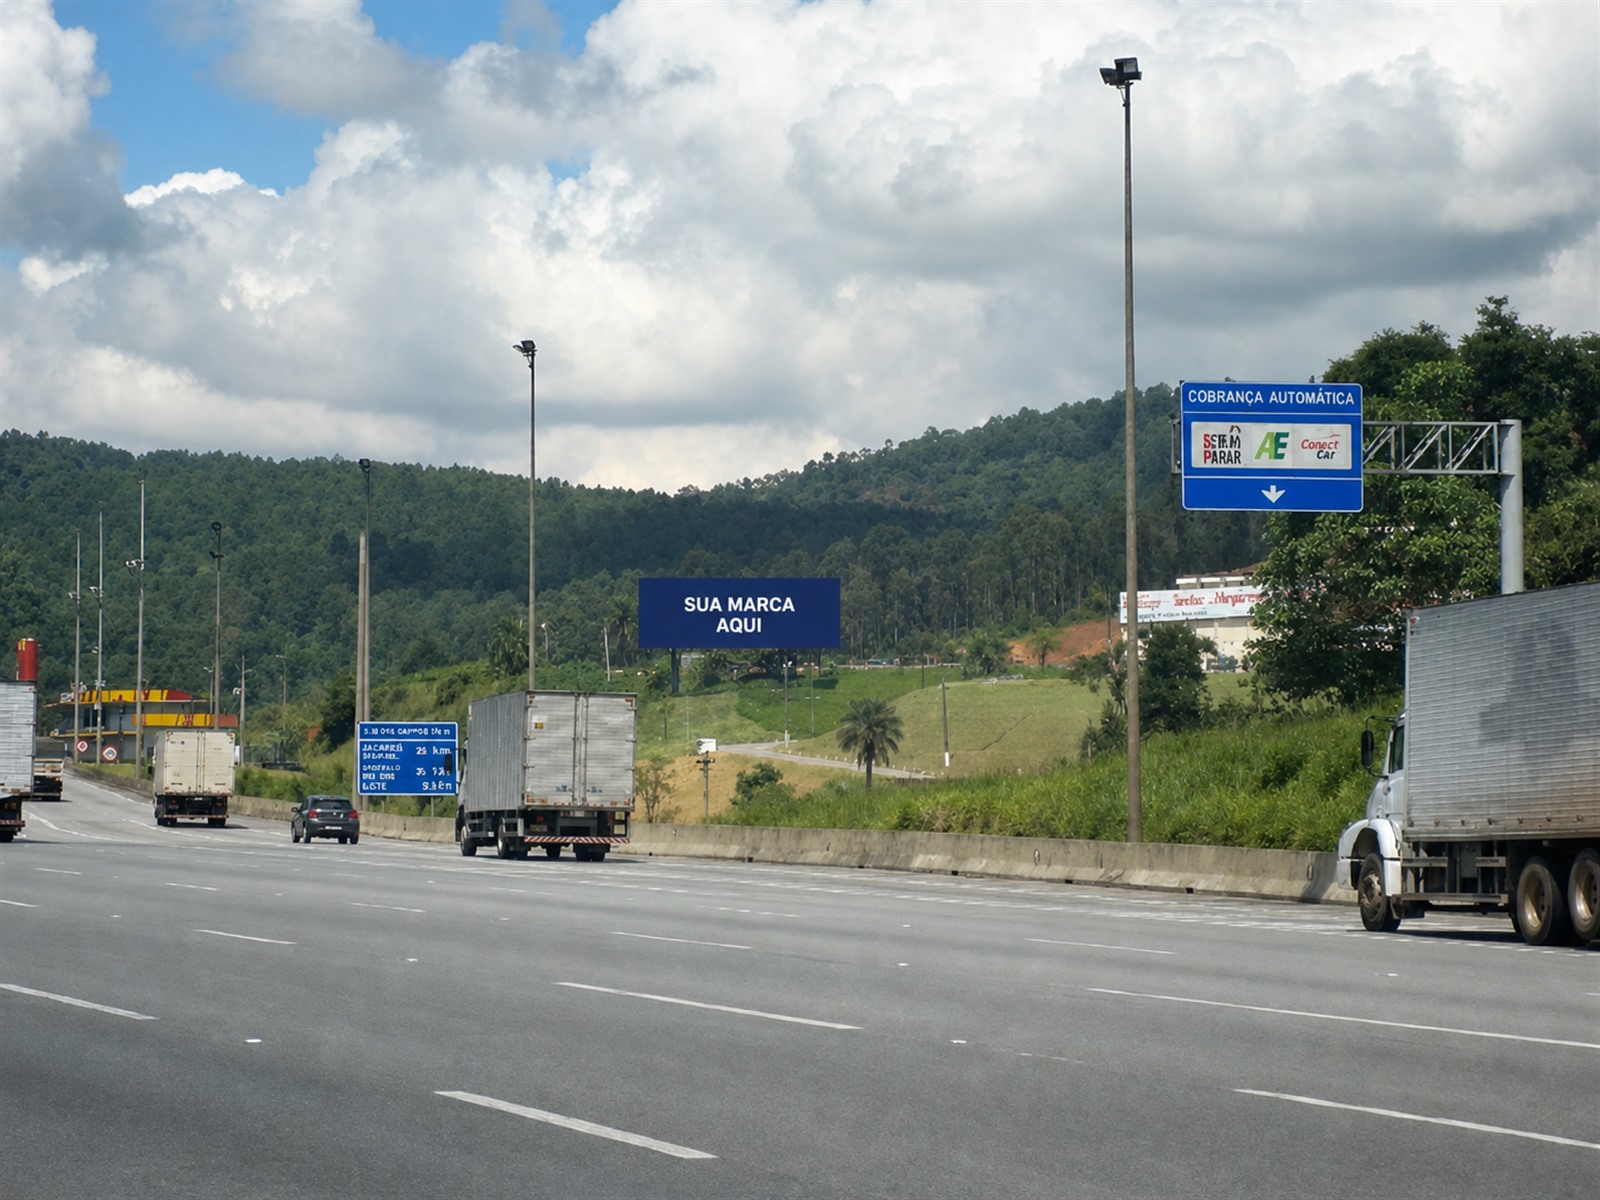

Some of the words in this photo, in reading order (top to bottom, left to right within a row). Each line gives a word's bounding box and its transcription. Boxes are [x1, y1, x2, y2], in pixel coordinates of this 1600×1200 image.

[1188, 390, 1264, 407] COBRANÇA
[1269, 388, 1355, 406] AUTOMÁTICA
[1301, 439, 1340, 450] Conect
[1204, 450, 1242, 465] PARAR
[684, 596, 723, 612] SUA
[728, 596, 796, 612] MARCA
[716, 617, 762, 634] AQUI
